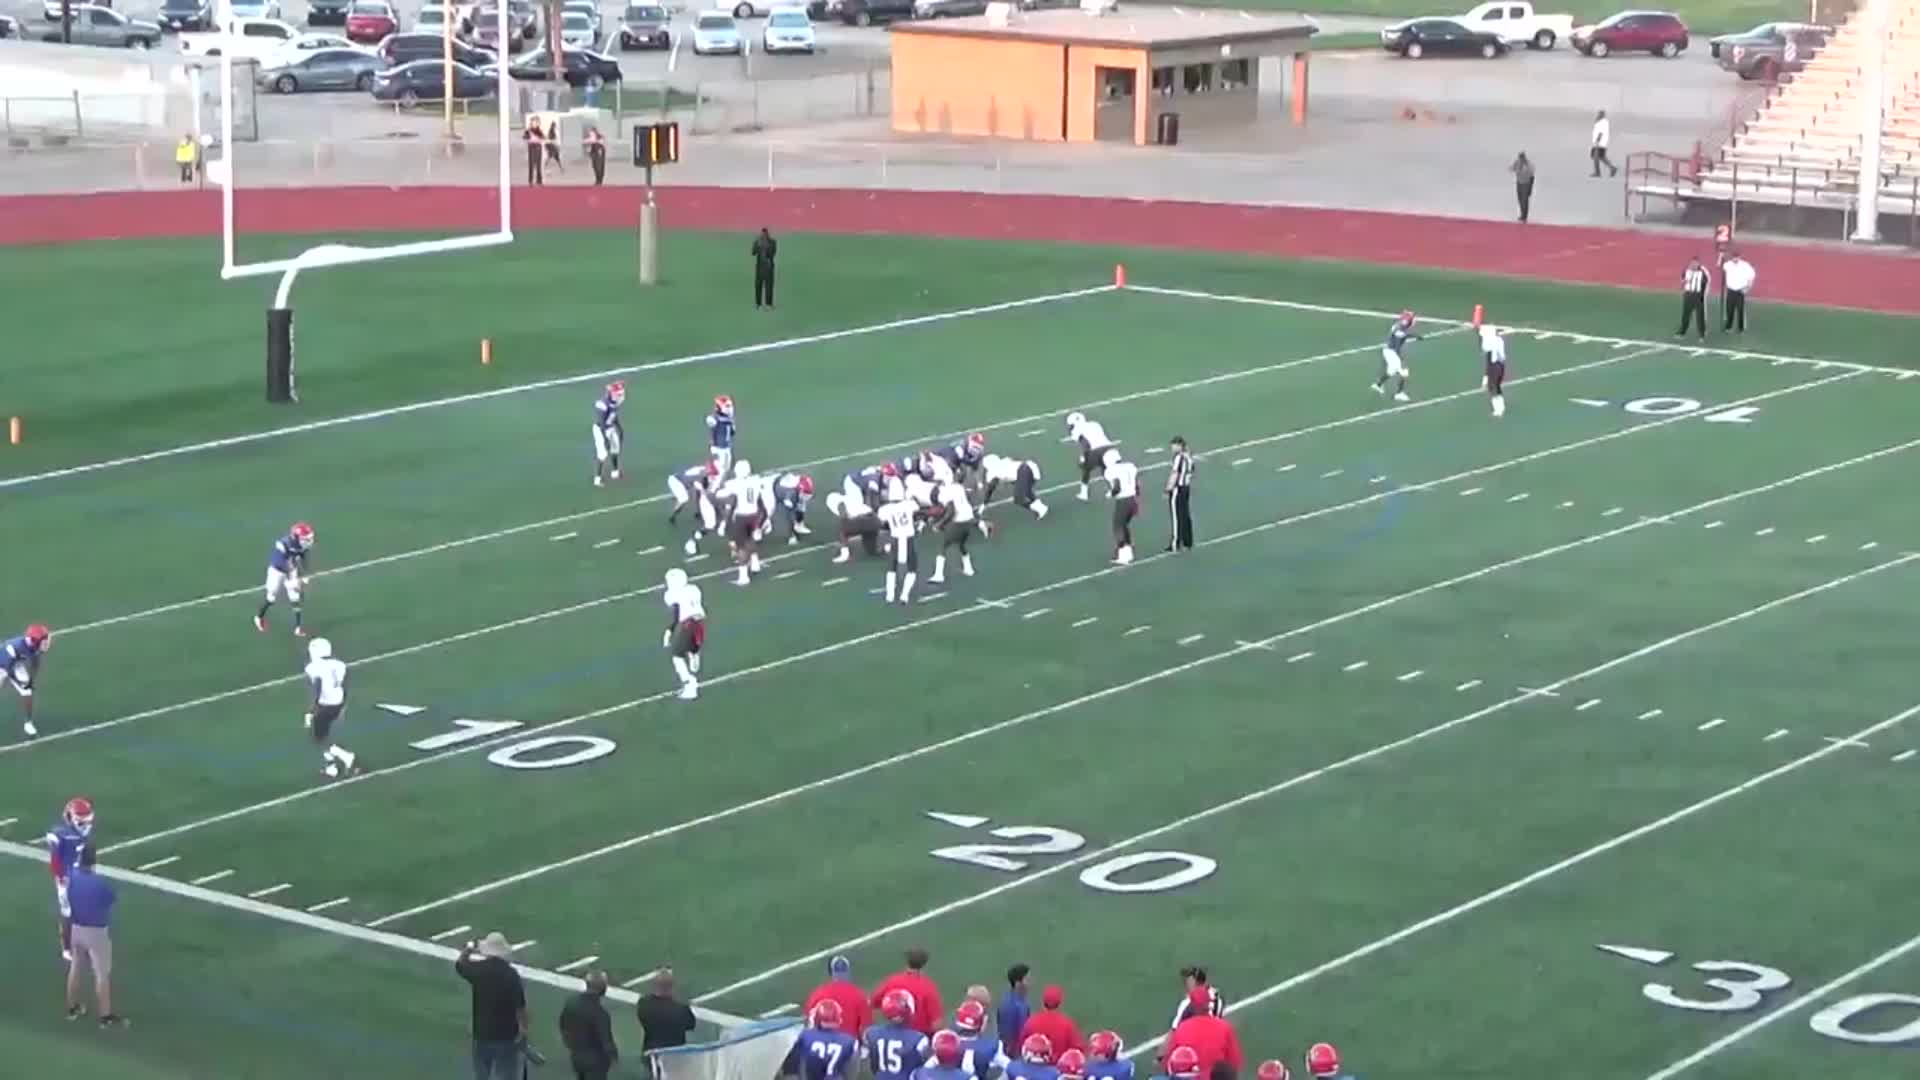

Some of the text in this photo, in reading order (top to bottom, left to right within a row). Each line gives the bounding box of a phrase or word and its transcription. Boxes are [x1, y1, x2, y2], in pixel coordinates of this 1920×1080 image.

[1716, 224, 1729, 241] 2
[409, 719, 617, 769] 10
[928, 825, 1217, 891] 20
[1642, 960, 1920, 1042] 30
[877, 1038, 903, 1074] 15
